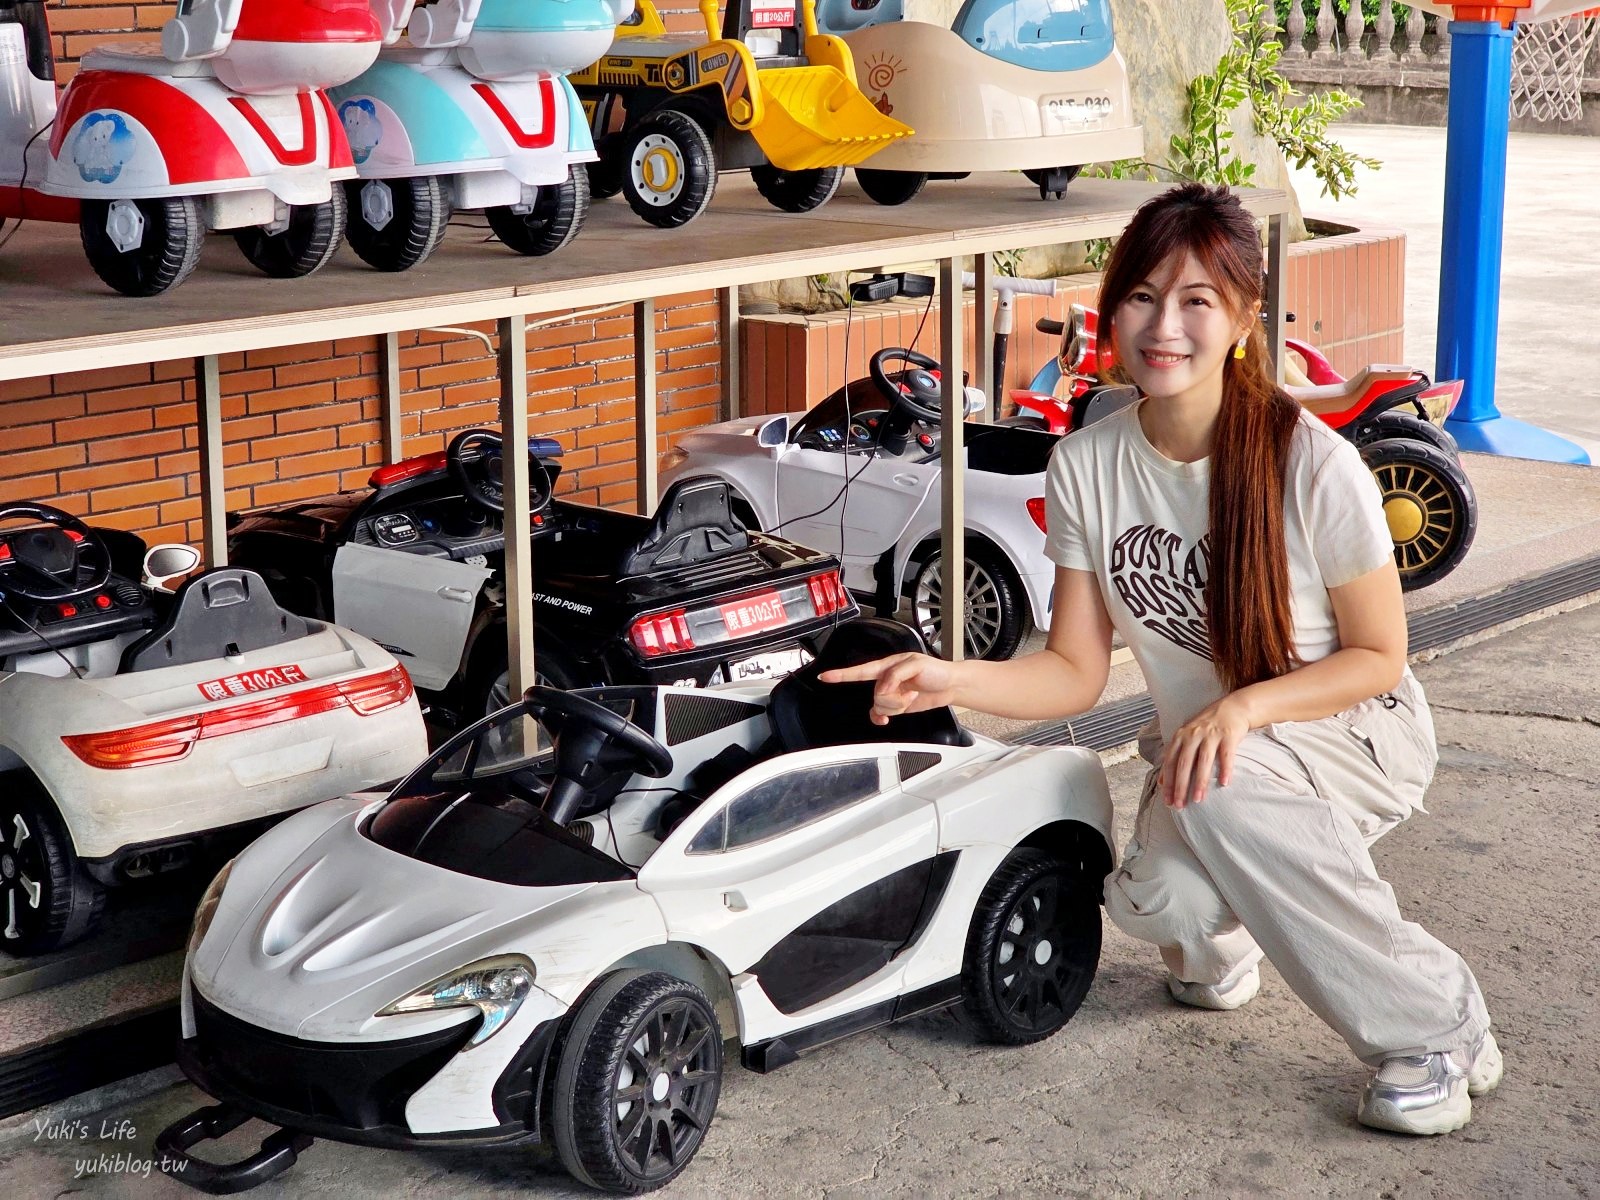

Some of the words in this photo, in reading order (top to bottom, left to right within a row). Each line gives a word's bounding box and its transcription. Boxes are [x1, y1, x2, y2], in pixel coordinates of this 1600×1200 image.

[755, 11, 791, 23] 限重20公斤
[543, 595, 562, 606] AND
[561, 600, 593, 615] POWER
[1112, 571, 1208, 619] BOST
[725, 599, 782, 630] 限重30公斤
[203, 666, 301, 700] 限重30公斤
